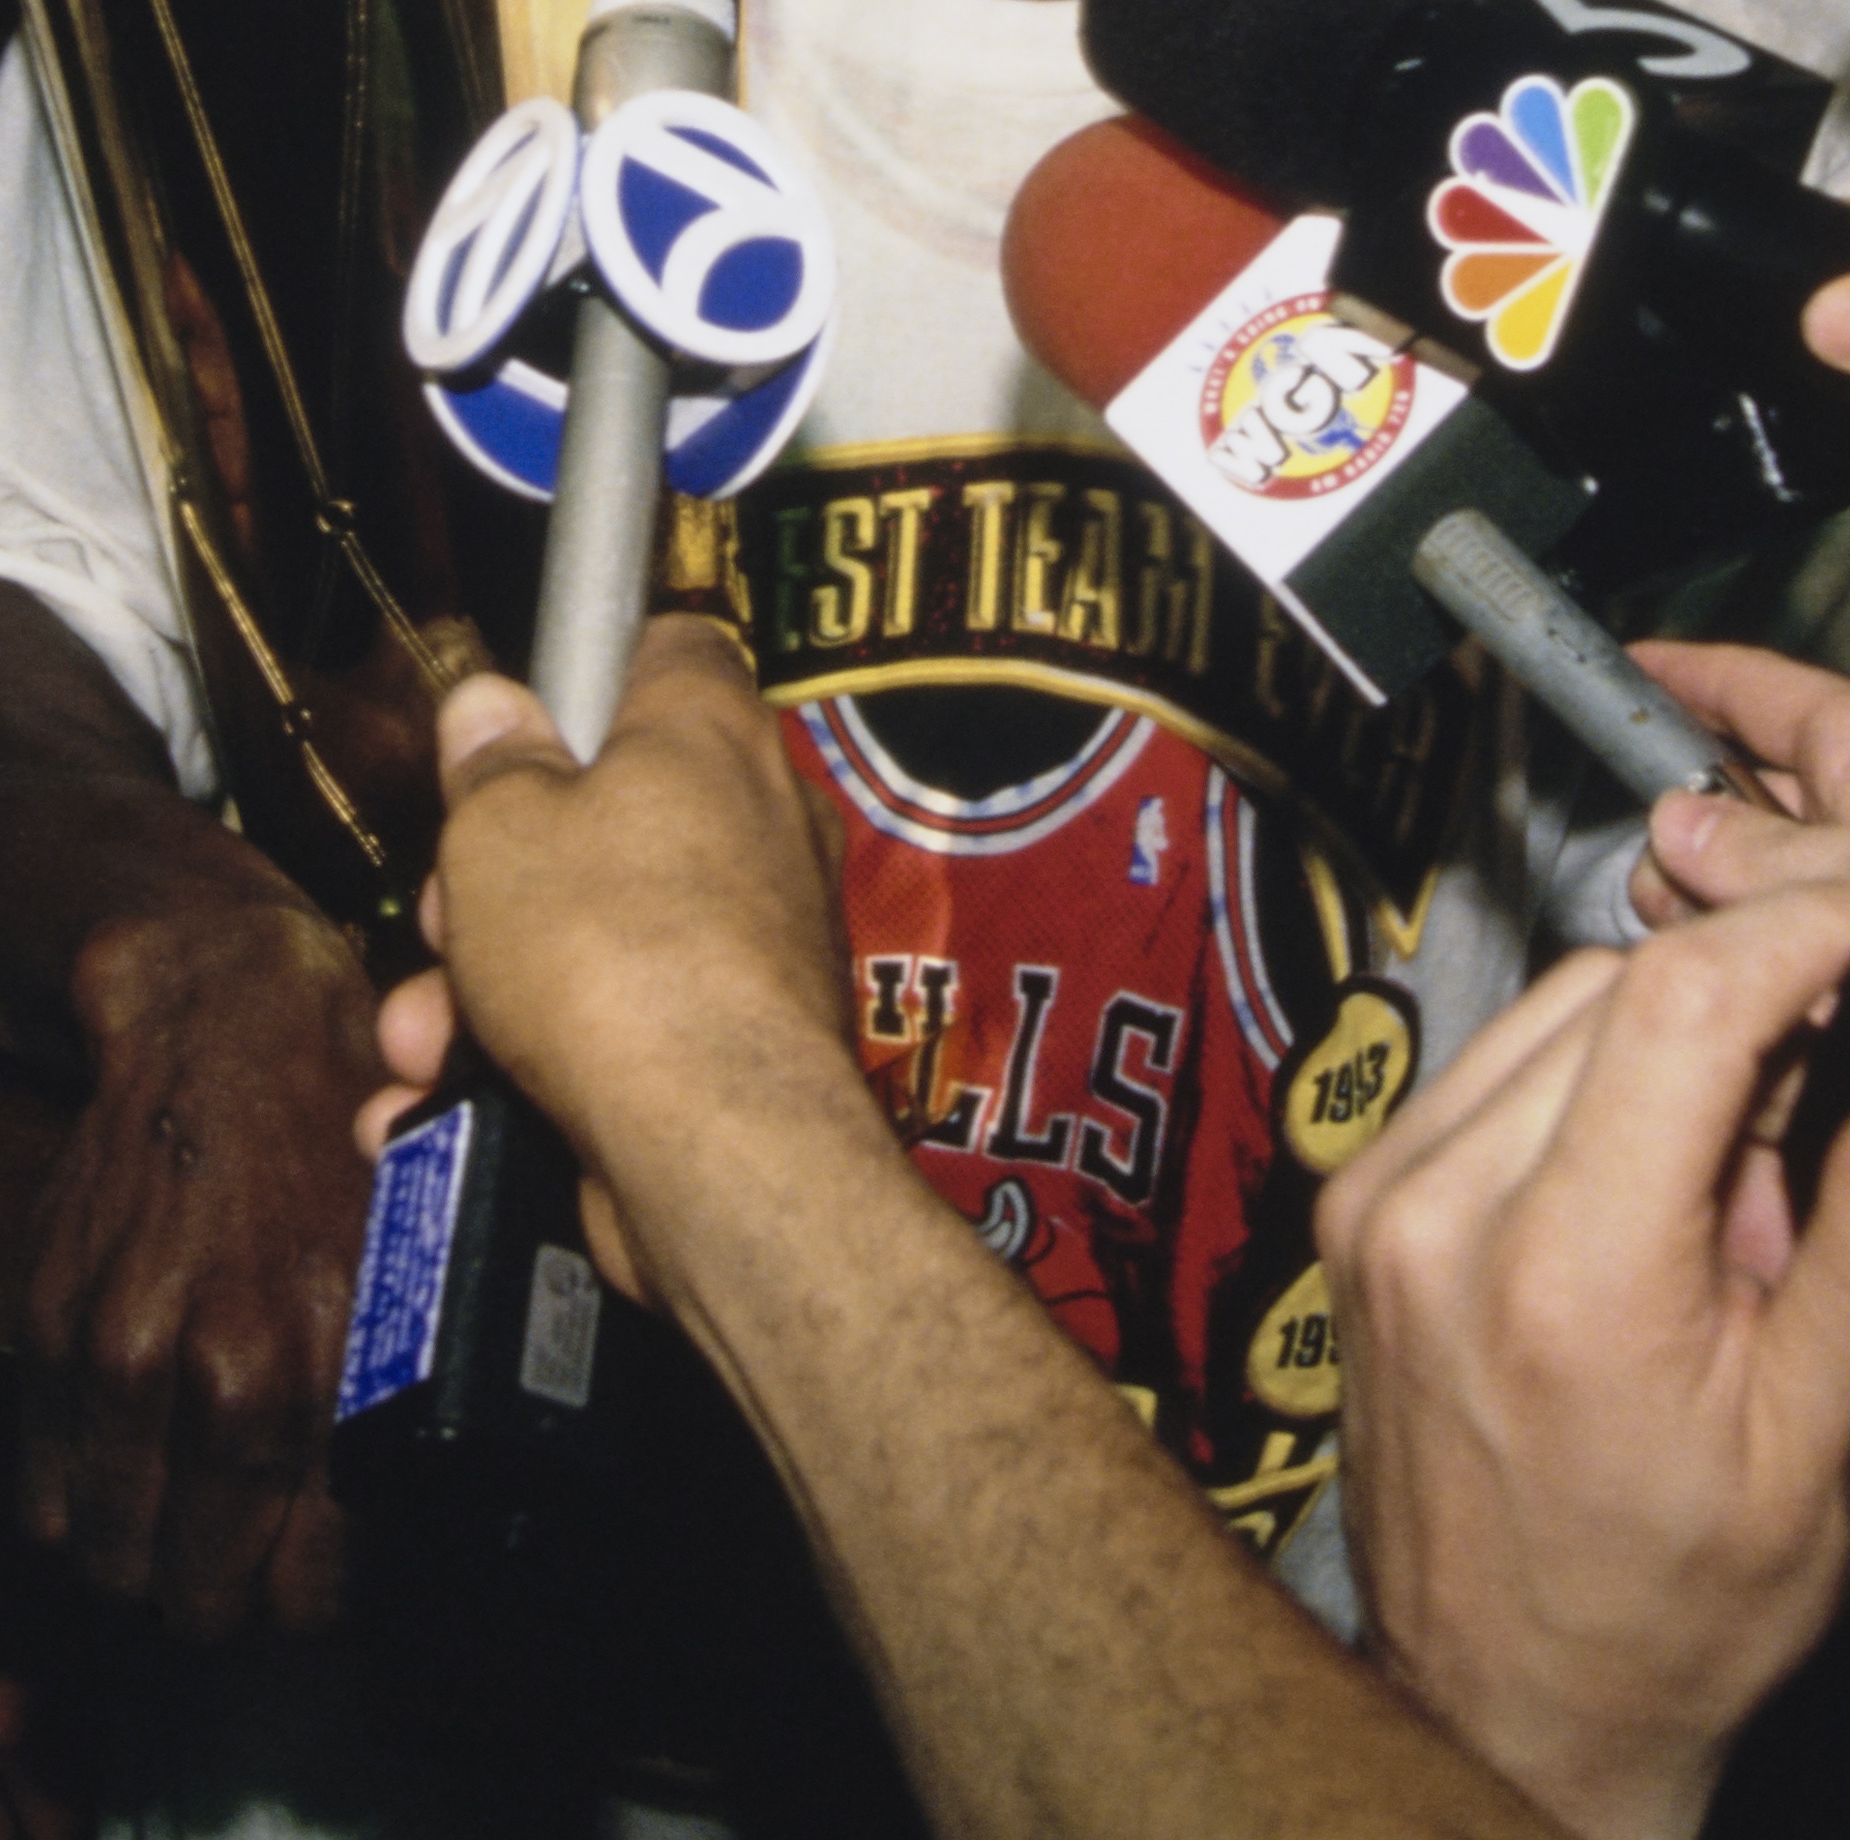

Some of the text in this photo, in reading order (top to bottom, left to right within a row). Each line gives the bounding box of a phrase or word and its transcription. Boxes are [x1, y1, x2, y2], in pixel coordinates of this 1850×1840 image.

[1205, 321, 1398, 486] WGN
[772, 486, 932, 652] EST
[1276, 1312, 1338, 1369] 19
